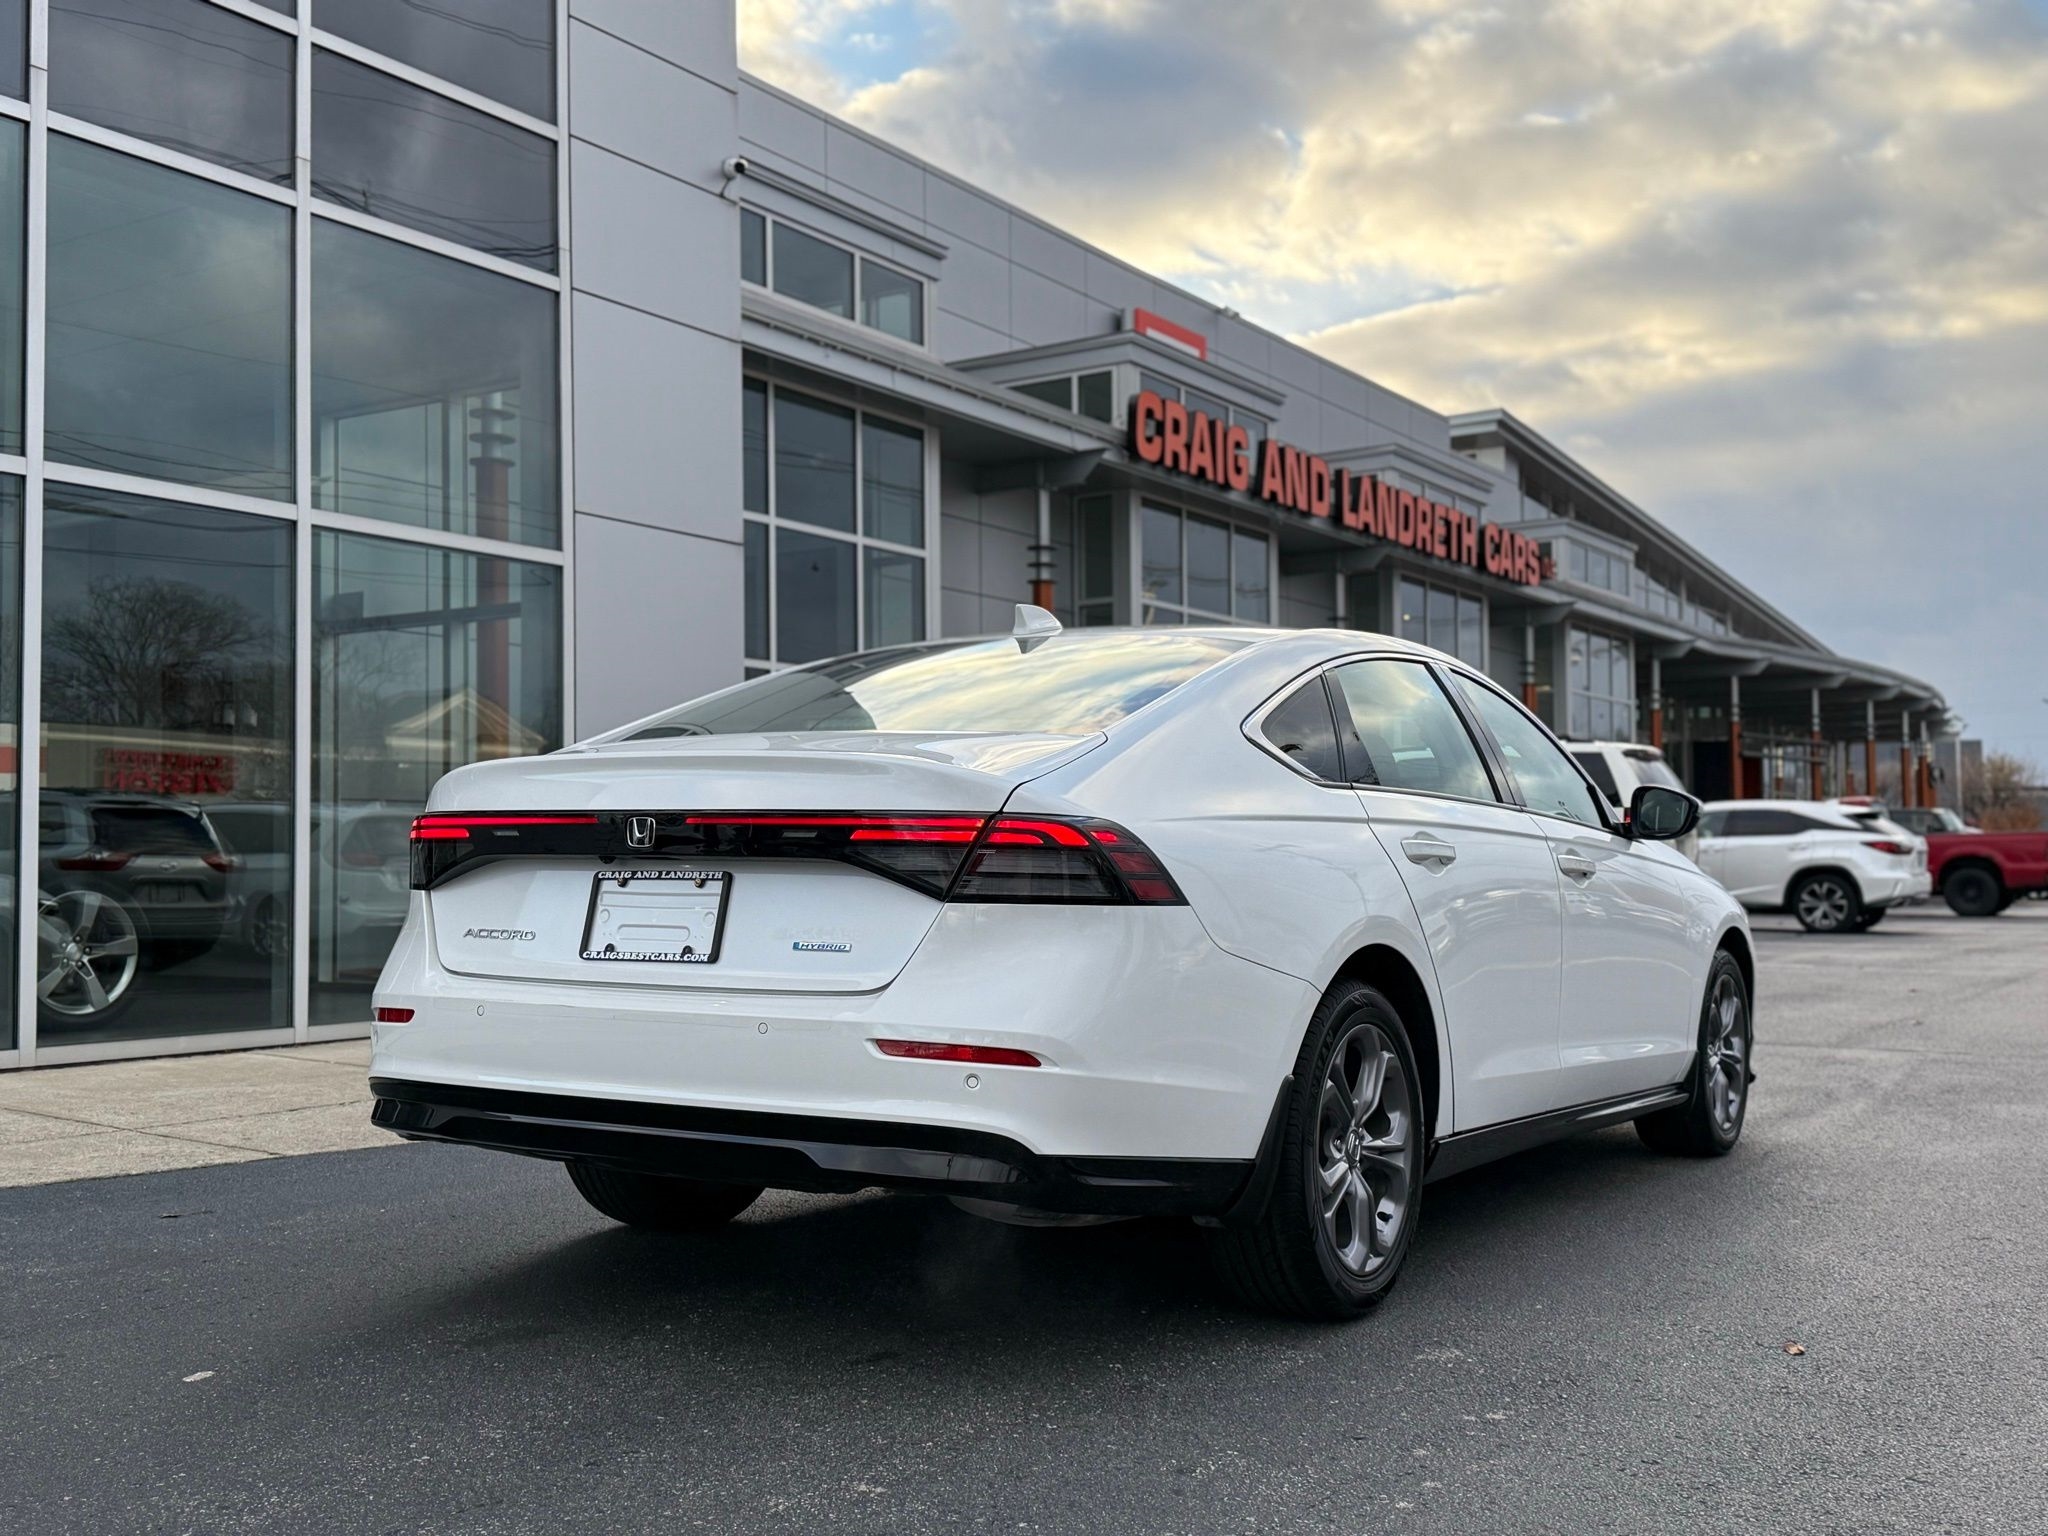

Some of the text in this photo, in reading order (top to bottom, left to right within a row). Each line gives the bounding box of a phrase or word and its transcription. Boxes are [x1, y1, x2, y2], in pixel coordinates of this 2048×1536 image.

[1135, 390, 1541, 586] CRAIG AND LANDRETH CARS
[598, 871, 723, 879] CRAIG AND LANDRETH
[462, 928, 536, 941] ACCORD
[800, 943, 847, 951] HYBRID
[582, 951, 710, 962] CRAIGSBESTCARS.COM
